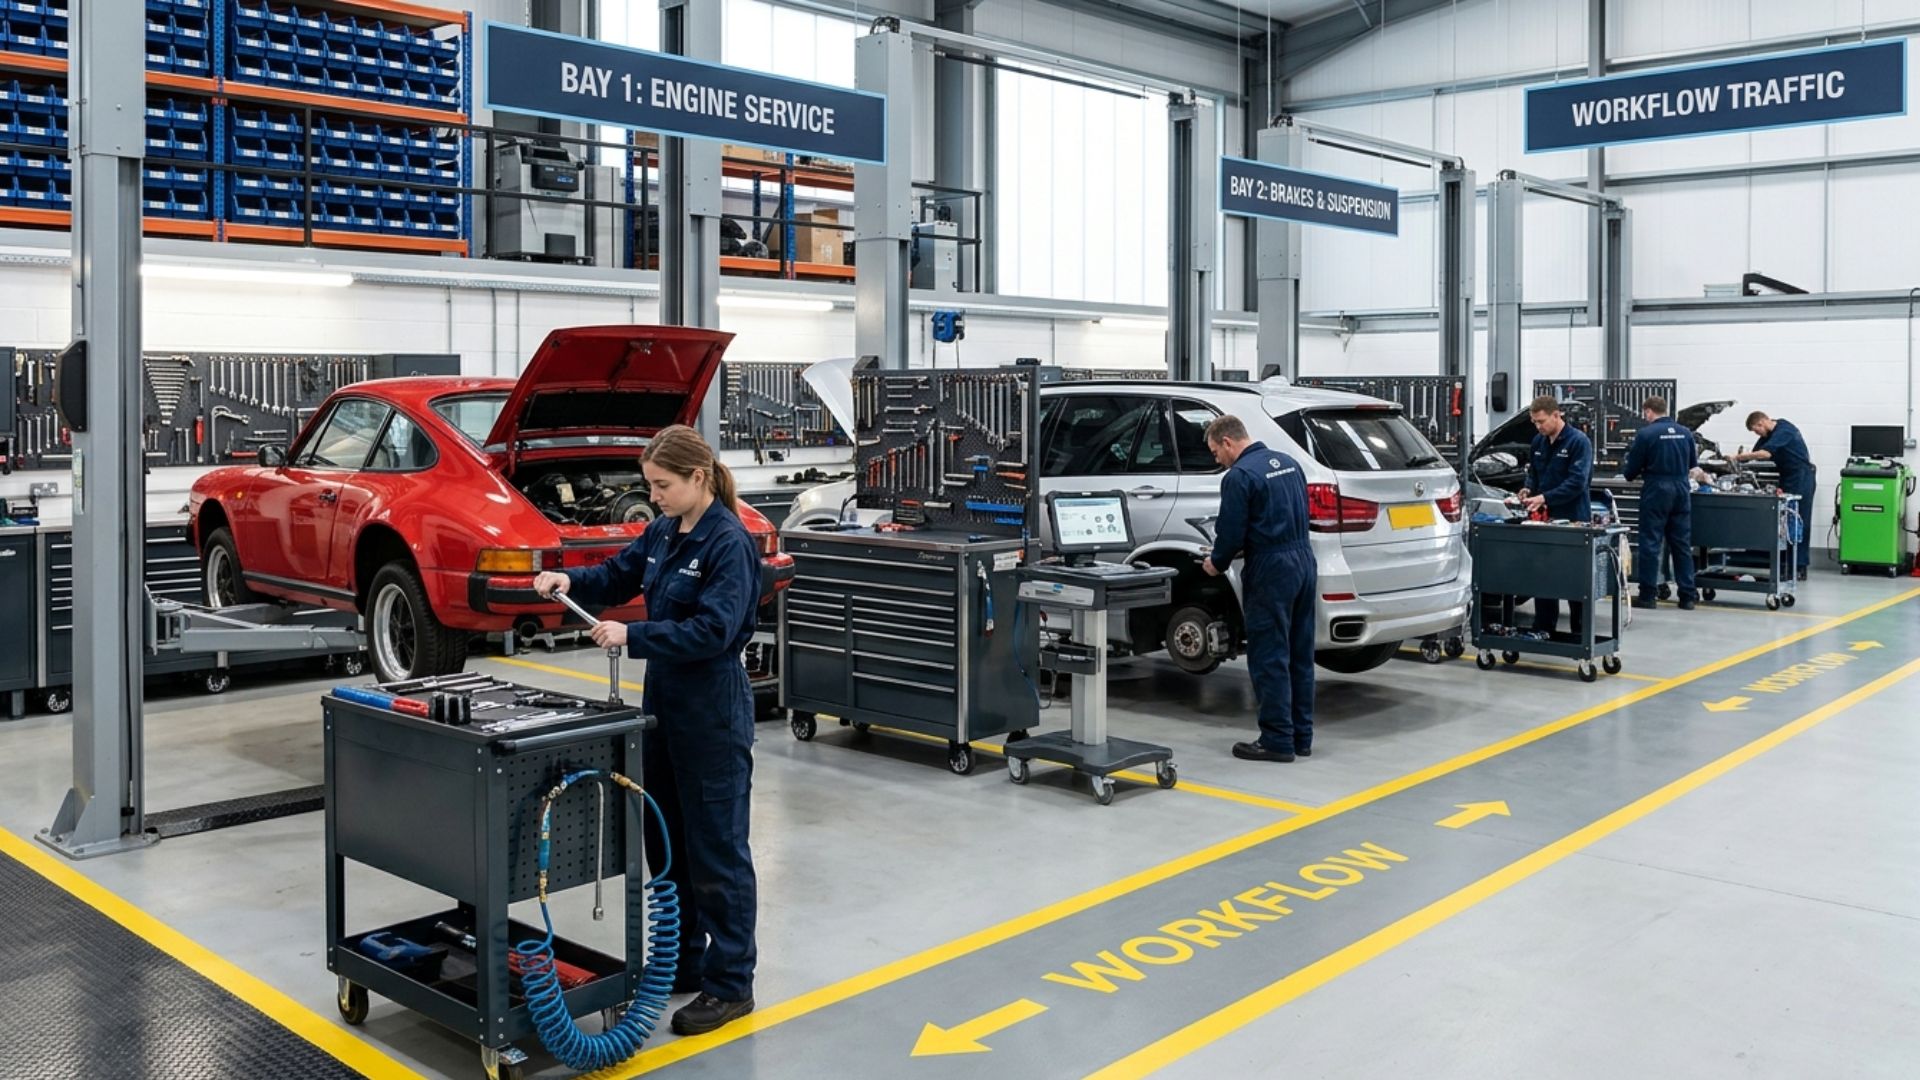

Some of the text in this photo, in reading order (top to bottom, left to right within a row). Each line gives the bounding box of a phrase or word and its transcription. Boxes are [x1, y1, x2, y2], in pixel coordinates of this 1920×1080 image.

[561, 62, 835, 135] BAY 1: ENGINE SERVICE
[1572, 71, 1845, 127] WORKFLOW TRAFFIC
[1230, 175, 1391, 221] BAY 2: BRAKES & SUSPENSION
[1040, 841, 1409, 994] WORKFLOW
